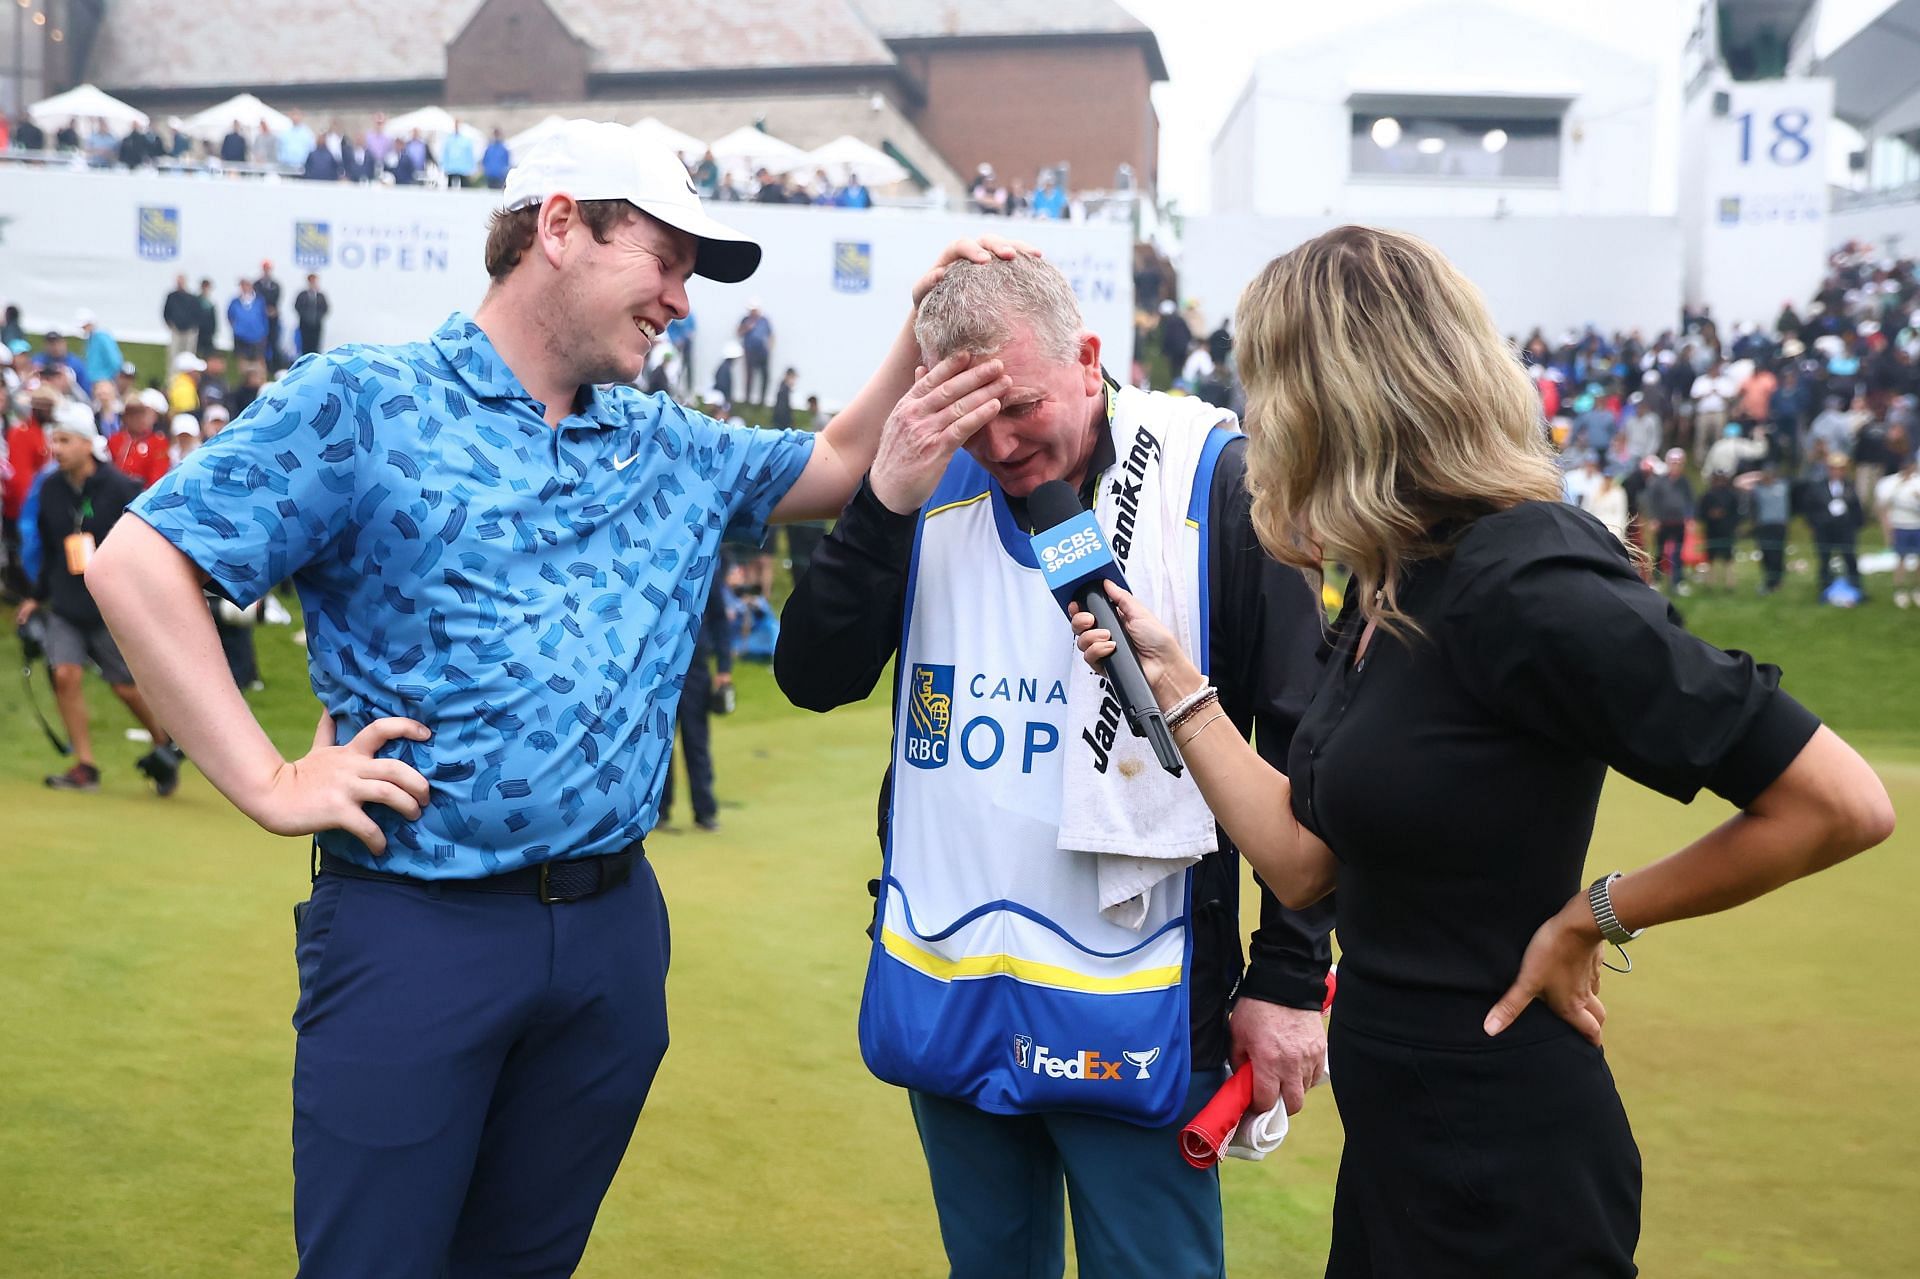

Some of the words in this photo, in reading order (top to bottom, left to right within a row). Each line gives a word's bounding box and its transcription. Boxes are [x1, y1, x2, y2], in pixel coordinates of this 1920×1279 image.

[1738, 107, 1811, 166] 18
[337, 243, 449, 272] OPEN
[1046, 538, 1102, 573] SPORTS
[1057, 526, 1097, 553] CBS
[908, 737, 945, 763] RBC
[1032, 1045, 1123, 1081] FedEx
